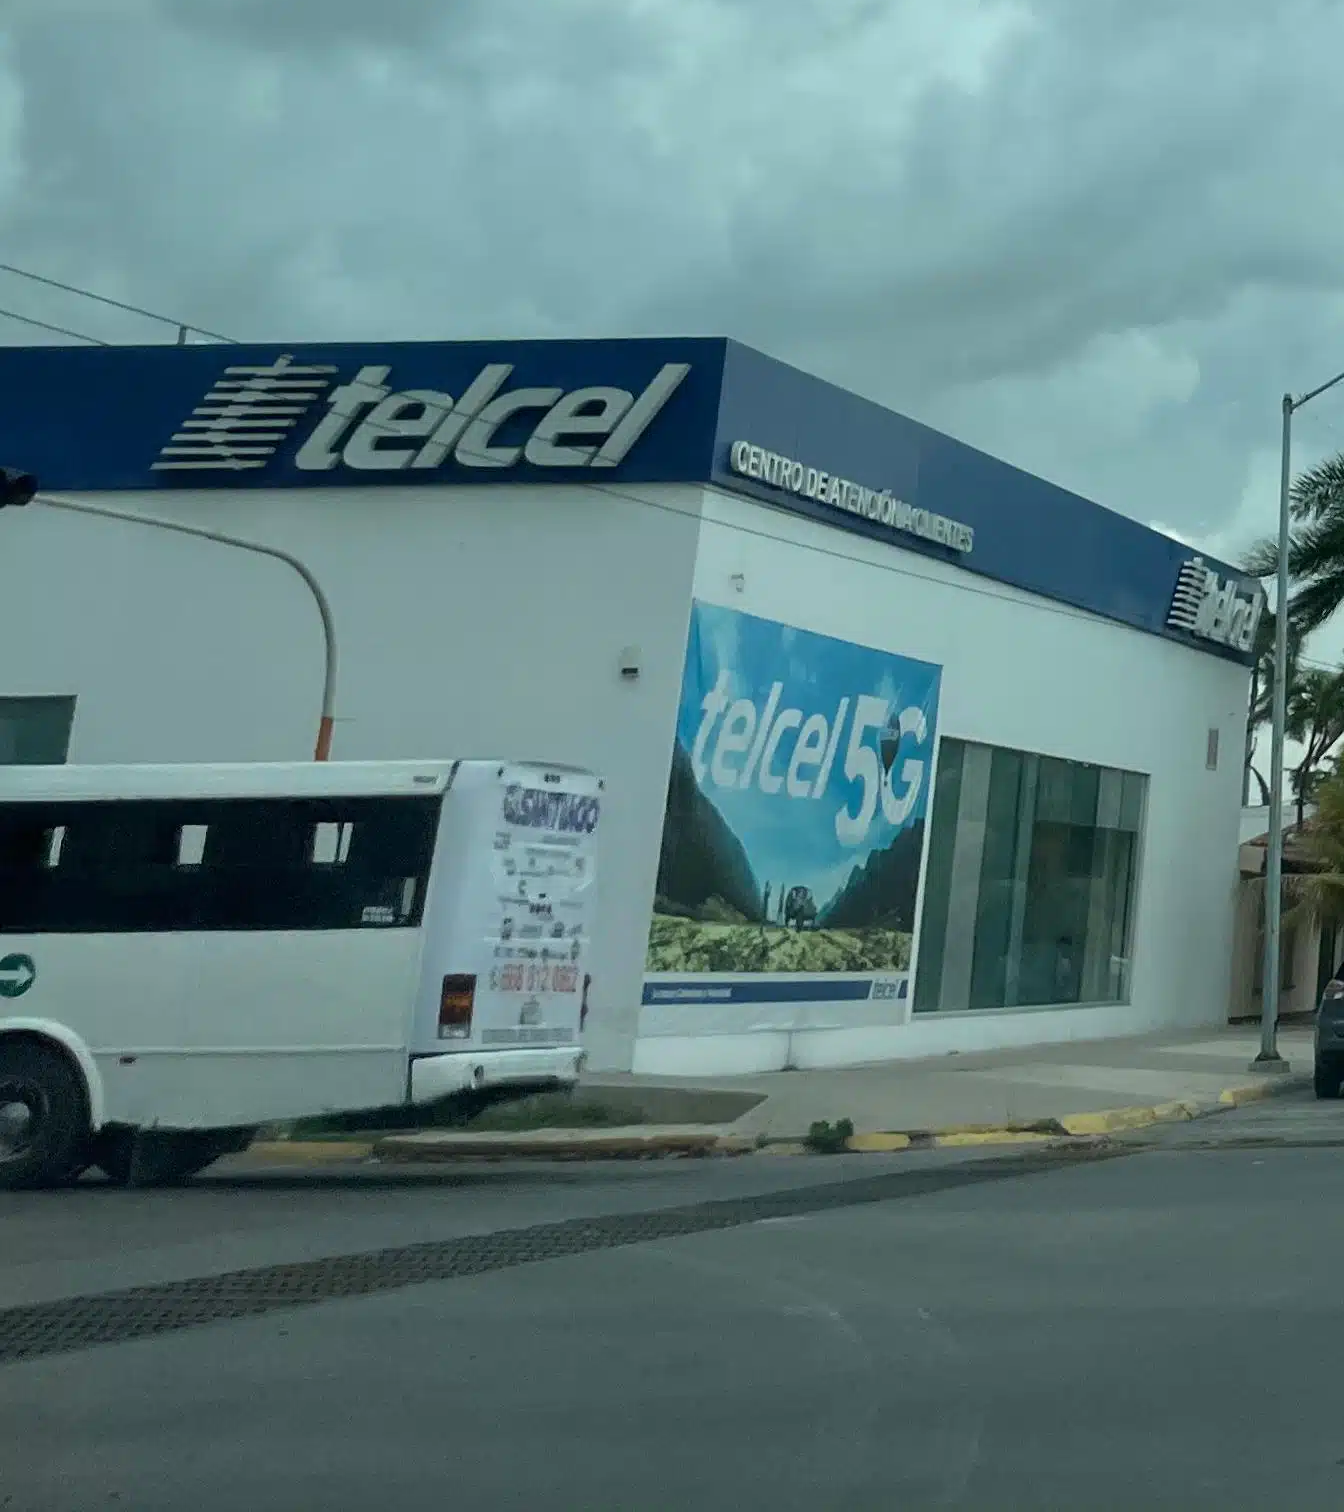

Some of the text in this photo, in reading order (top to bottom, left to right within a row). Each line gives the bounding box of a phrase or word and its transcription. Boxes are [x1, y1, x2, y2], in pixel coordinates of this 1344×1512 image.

[295, 363, 691, 471] telcel
[731, 441, 804, 491] CENTRO
[804, 468, 830, 501] DE
[827, 477, 899, 525] ATENCIÓN
[911, 508, 975, 553] CLIENTES
[691, 669, 927, 846] telcel 5G
